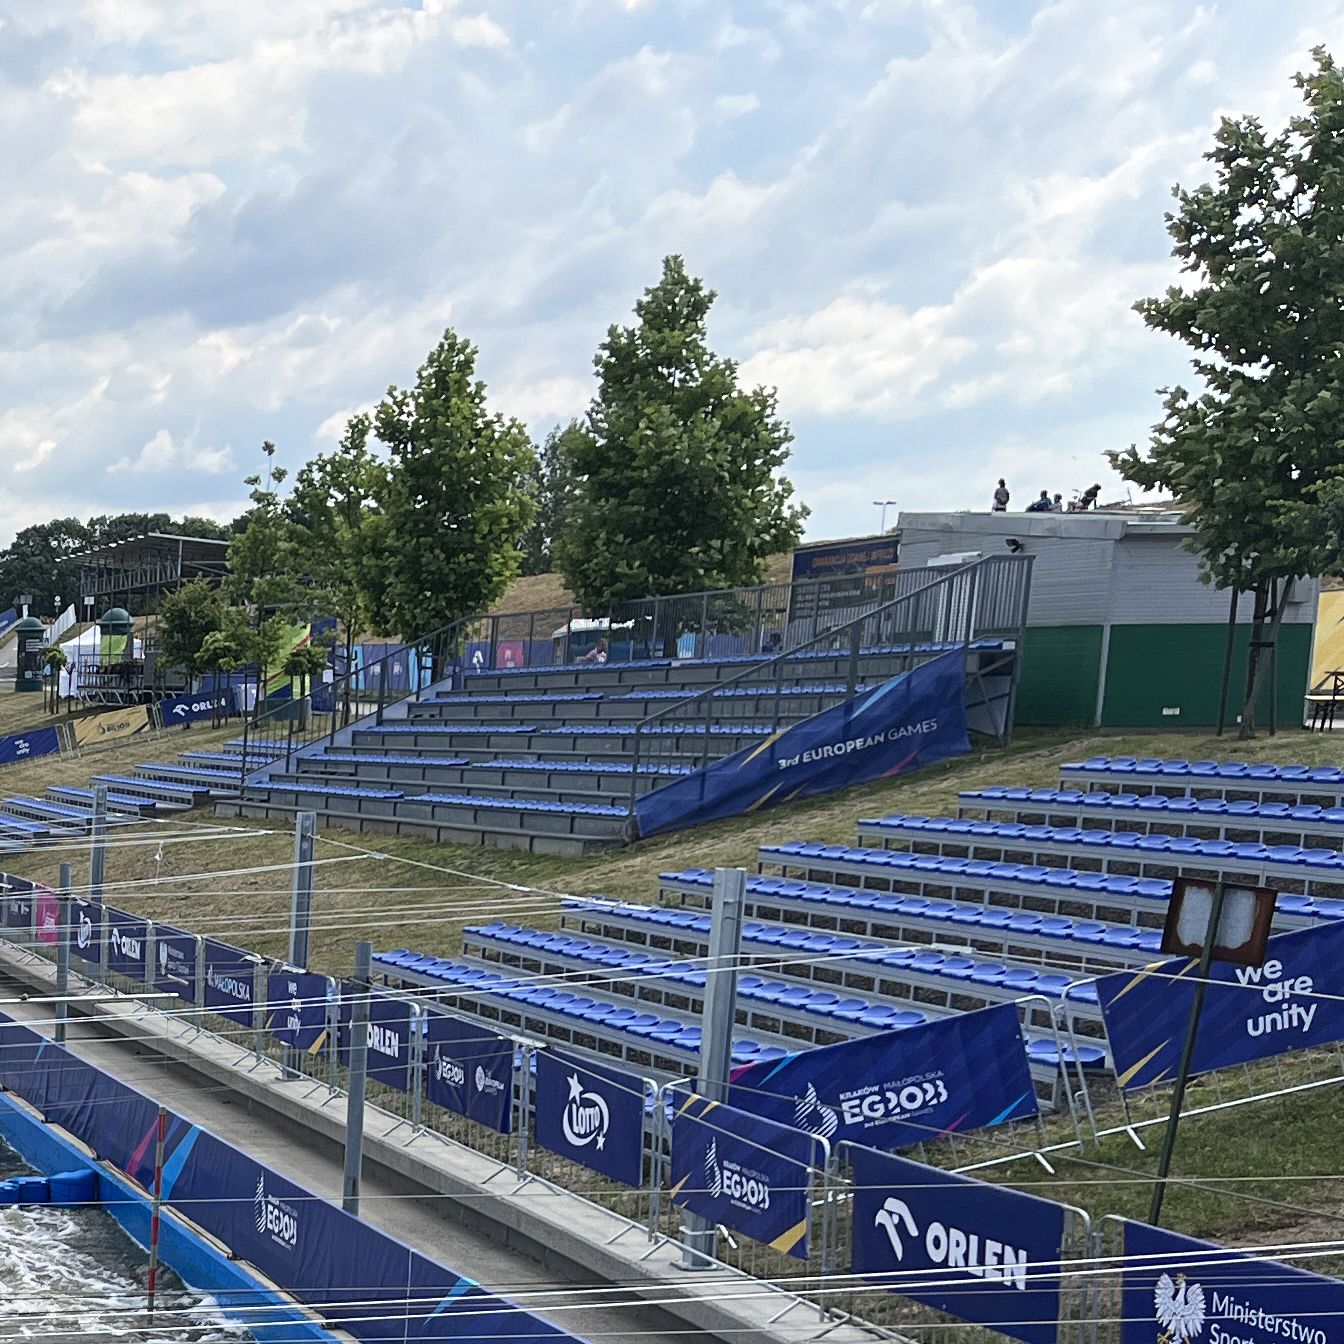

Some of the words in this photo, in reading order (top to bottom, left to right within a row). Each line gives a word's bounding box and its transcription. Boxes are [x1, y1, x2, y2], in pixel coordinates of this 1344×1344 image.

[778, 755, 799, 770] 3rd
[803, 732, 885, 763] EUROPEAN
[888, 718, 938, 742] GAMES
[214, 972, 251, 1001] MAŁOPOLSKA
[288, 979, 298, 996] we
[1235, 960, 1283, 985] we
[1263, 976, 1313, 1003] are
[1247, 1003, 1318, 1037] unity
[839, 1084, 880, 1100] KRAKÓW
[841, 1080, 949, 1125] EG2023
[572, 1103, 601, 1135] LOTTO
[723, 1169, 770, 1210] EG2023
[267, 1203, 297, 1245] EG2023
[926, 1222, 1027, 1291] ORLEN
